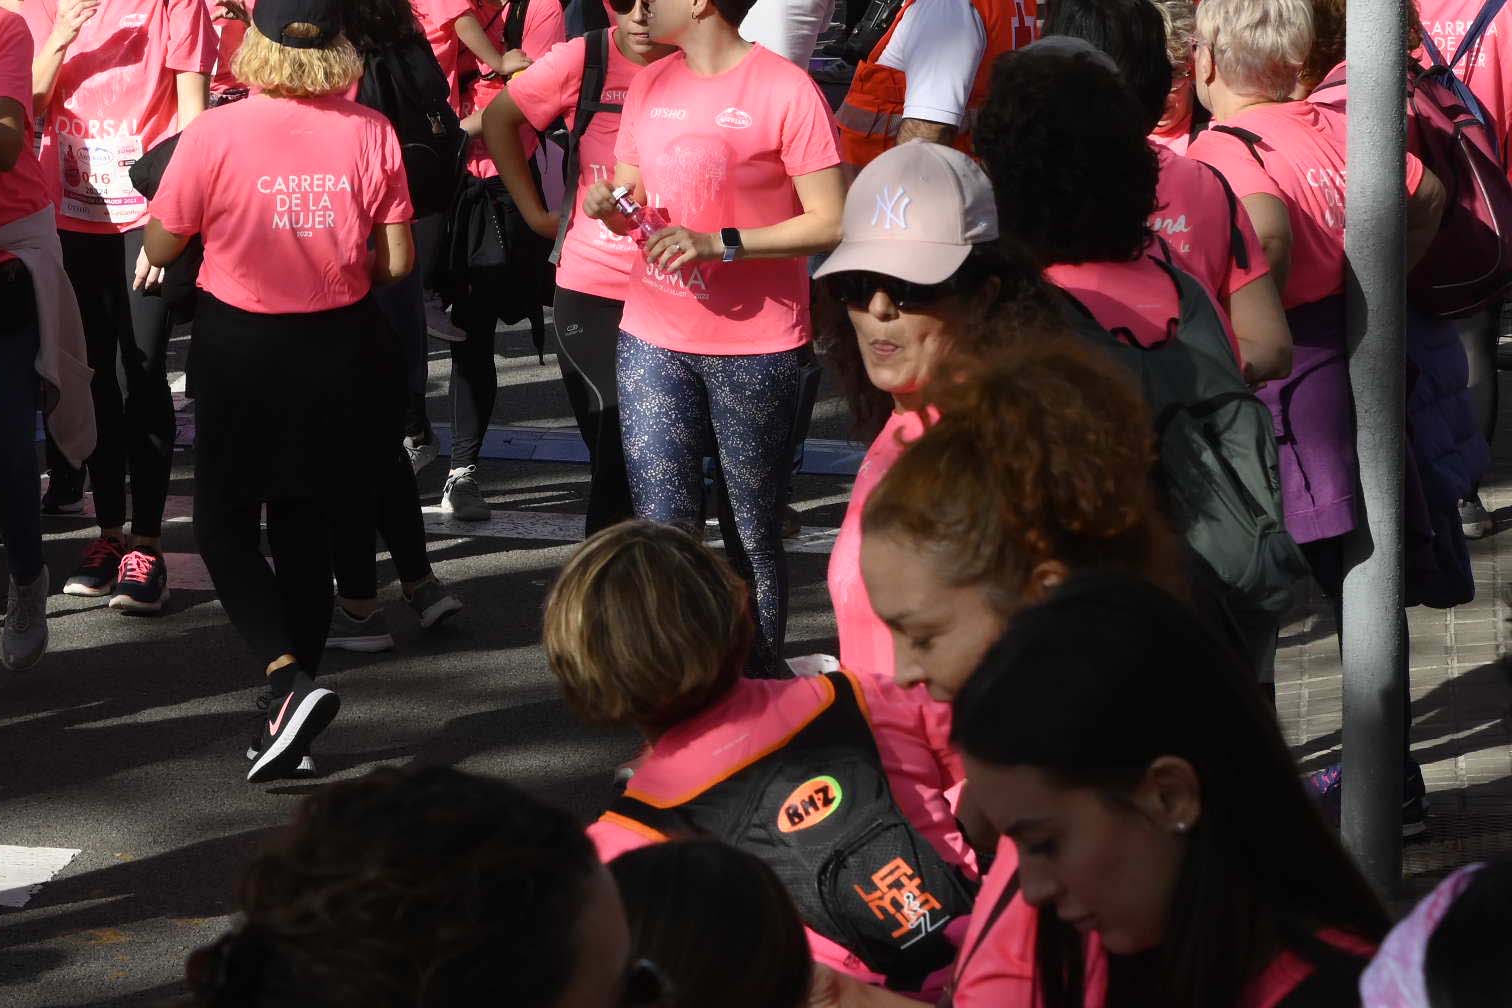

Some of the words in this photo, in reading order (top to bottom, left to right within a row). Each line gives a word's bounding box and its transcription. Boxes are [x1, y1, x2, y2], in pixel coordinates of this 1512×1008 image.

[257, 174, 350, 194] CARRERA
[275, 194, 303, 211] DE
[309, 193, 333, 210] LA
[271, 209, 336, 230] MUJER
